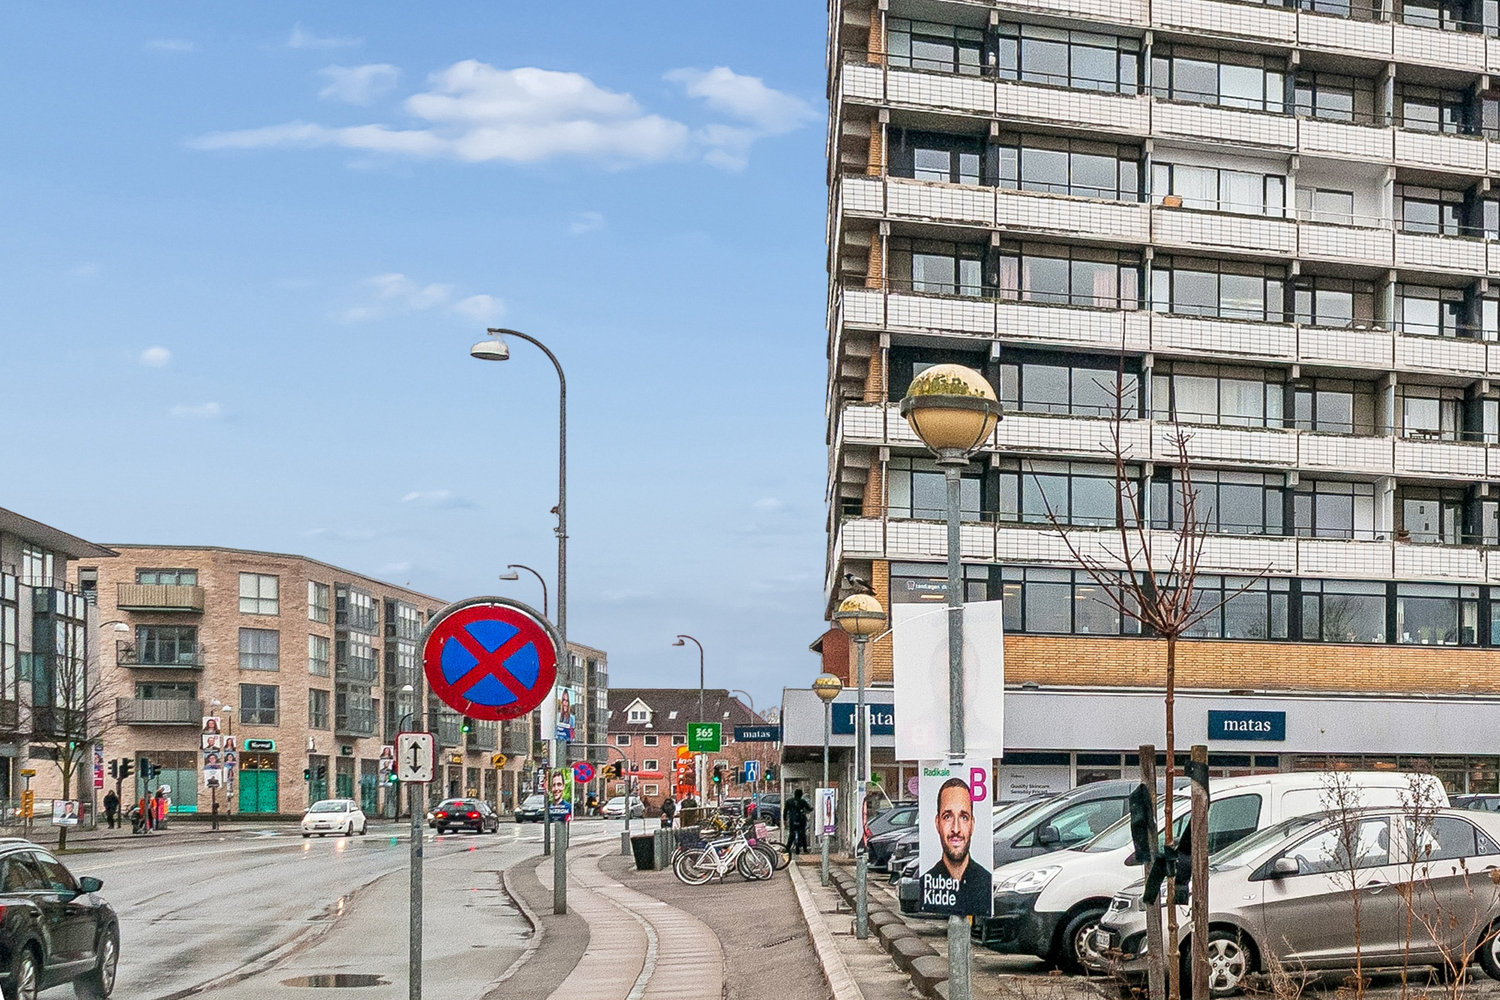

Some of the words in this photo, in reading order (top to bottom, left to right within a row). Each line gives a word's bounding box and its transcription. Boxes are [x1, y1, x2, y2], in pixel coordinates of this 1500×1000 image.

[695, 727, 714, 737] 365
[1223, 718, 1272, 733] matas
[743, 731, 771, 739] matas
[923, 767, 950, 777] Radikale
[969, 767, 987, 802] B
[924, 874, 960, 892] Ruben
[923, 889, 957, 906] Kidde
